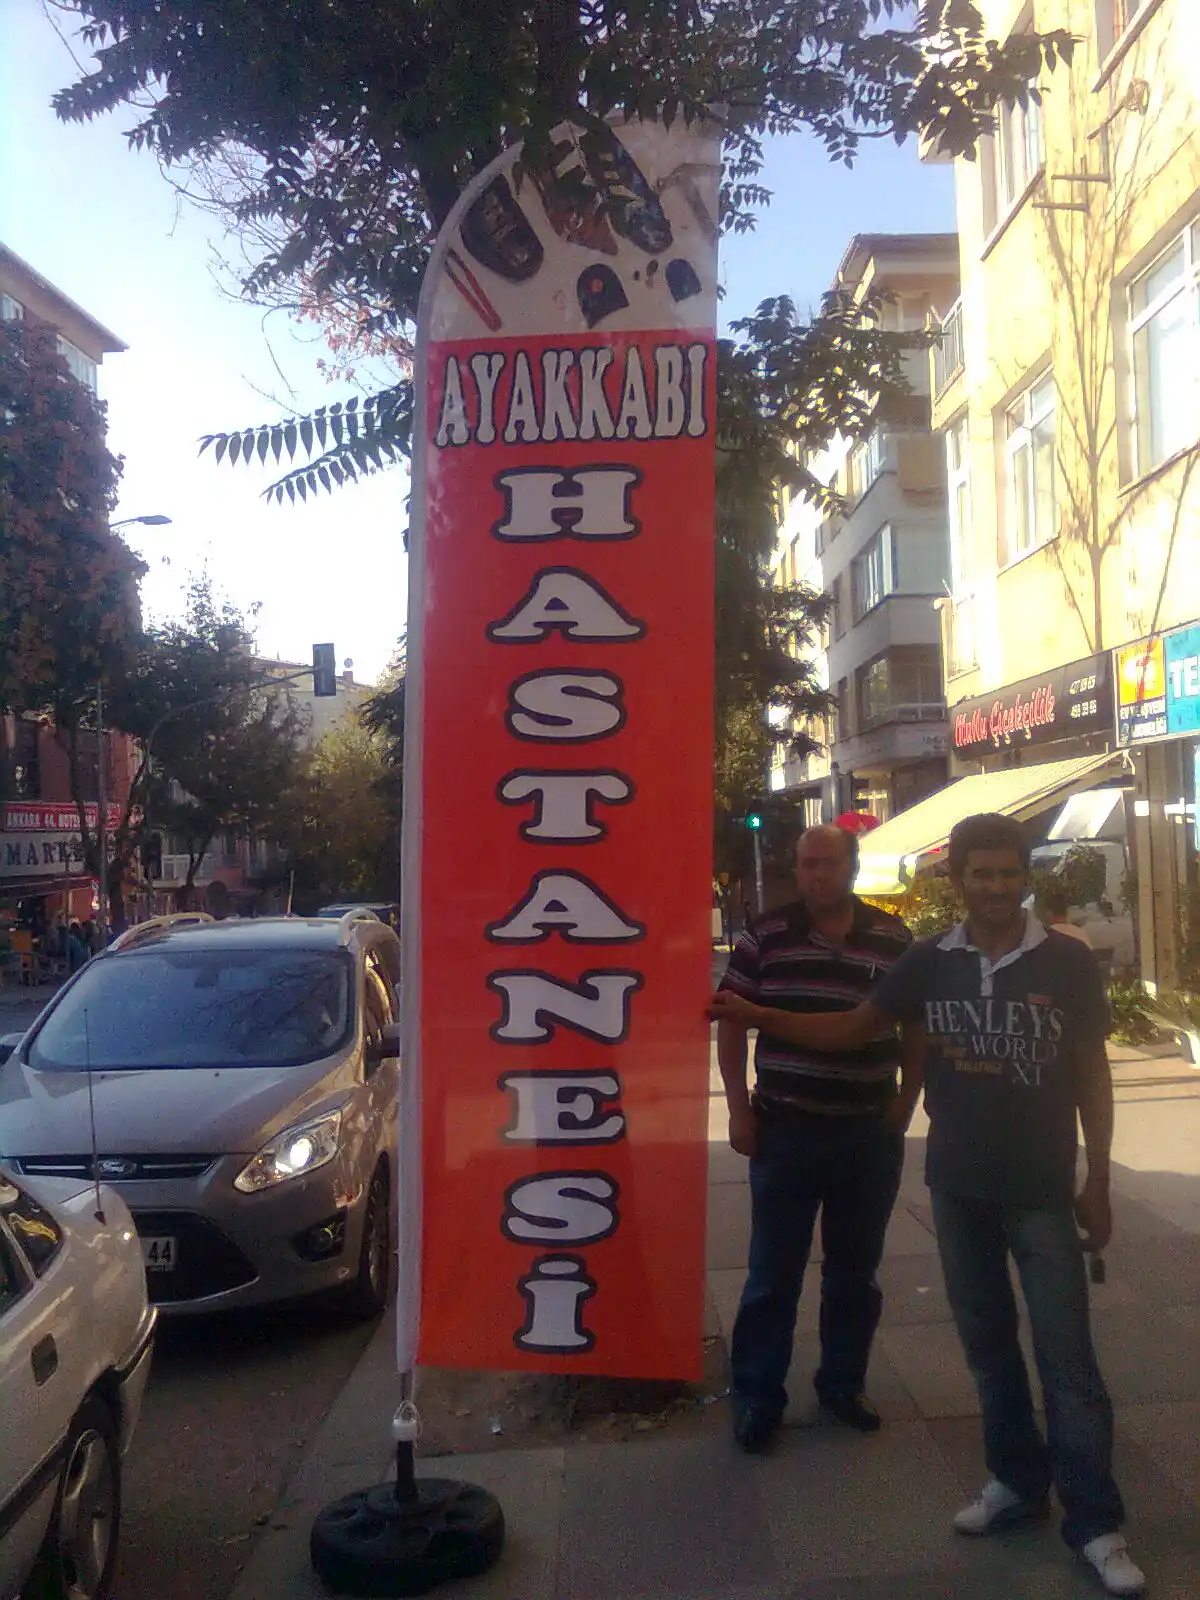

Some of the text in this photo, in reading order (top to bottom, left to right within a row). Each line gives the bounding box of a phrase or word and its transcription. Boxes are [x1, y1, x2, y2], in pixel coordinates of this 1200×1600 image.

[435, 344, 708, 448] AYAKKABI
[7, 812, 40, 829] ANKARA
[486, 463, 647, 1353] HASTANESİ
[925, 999, 1064, 1041] HENLEYS
[971, 1034, 1057, 1063] WORLD
